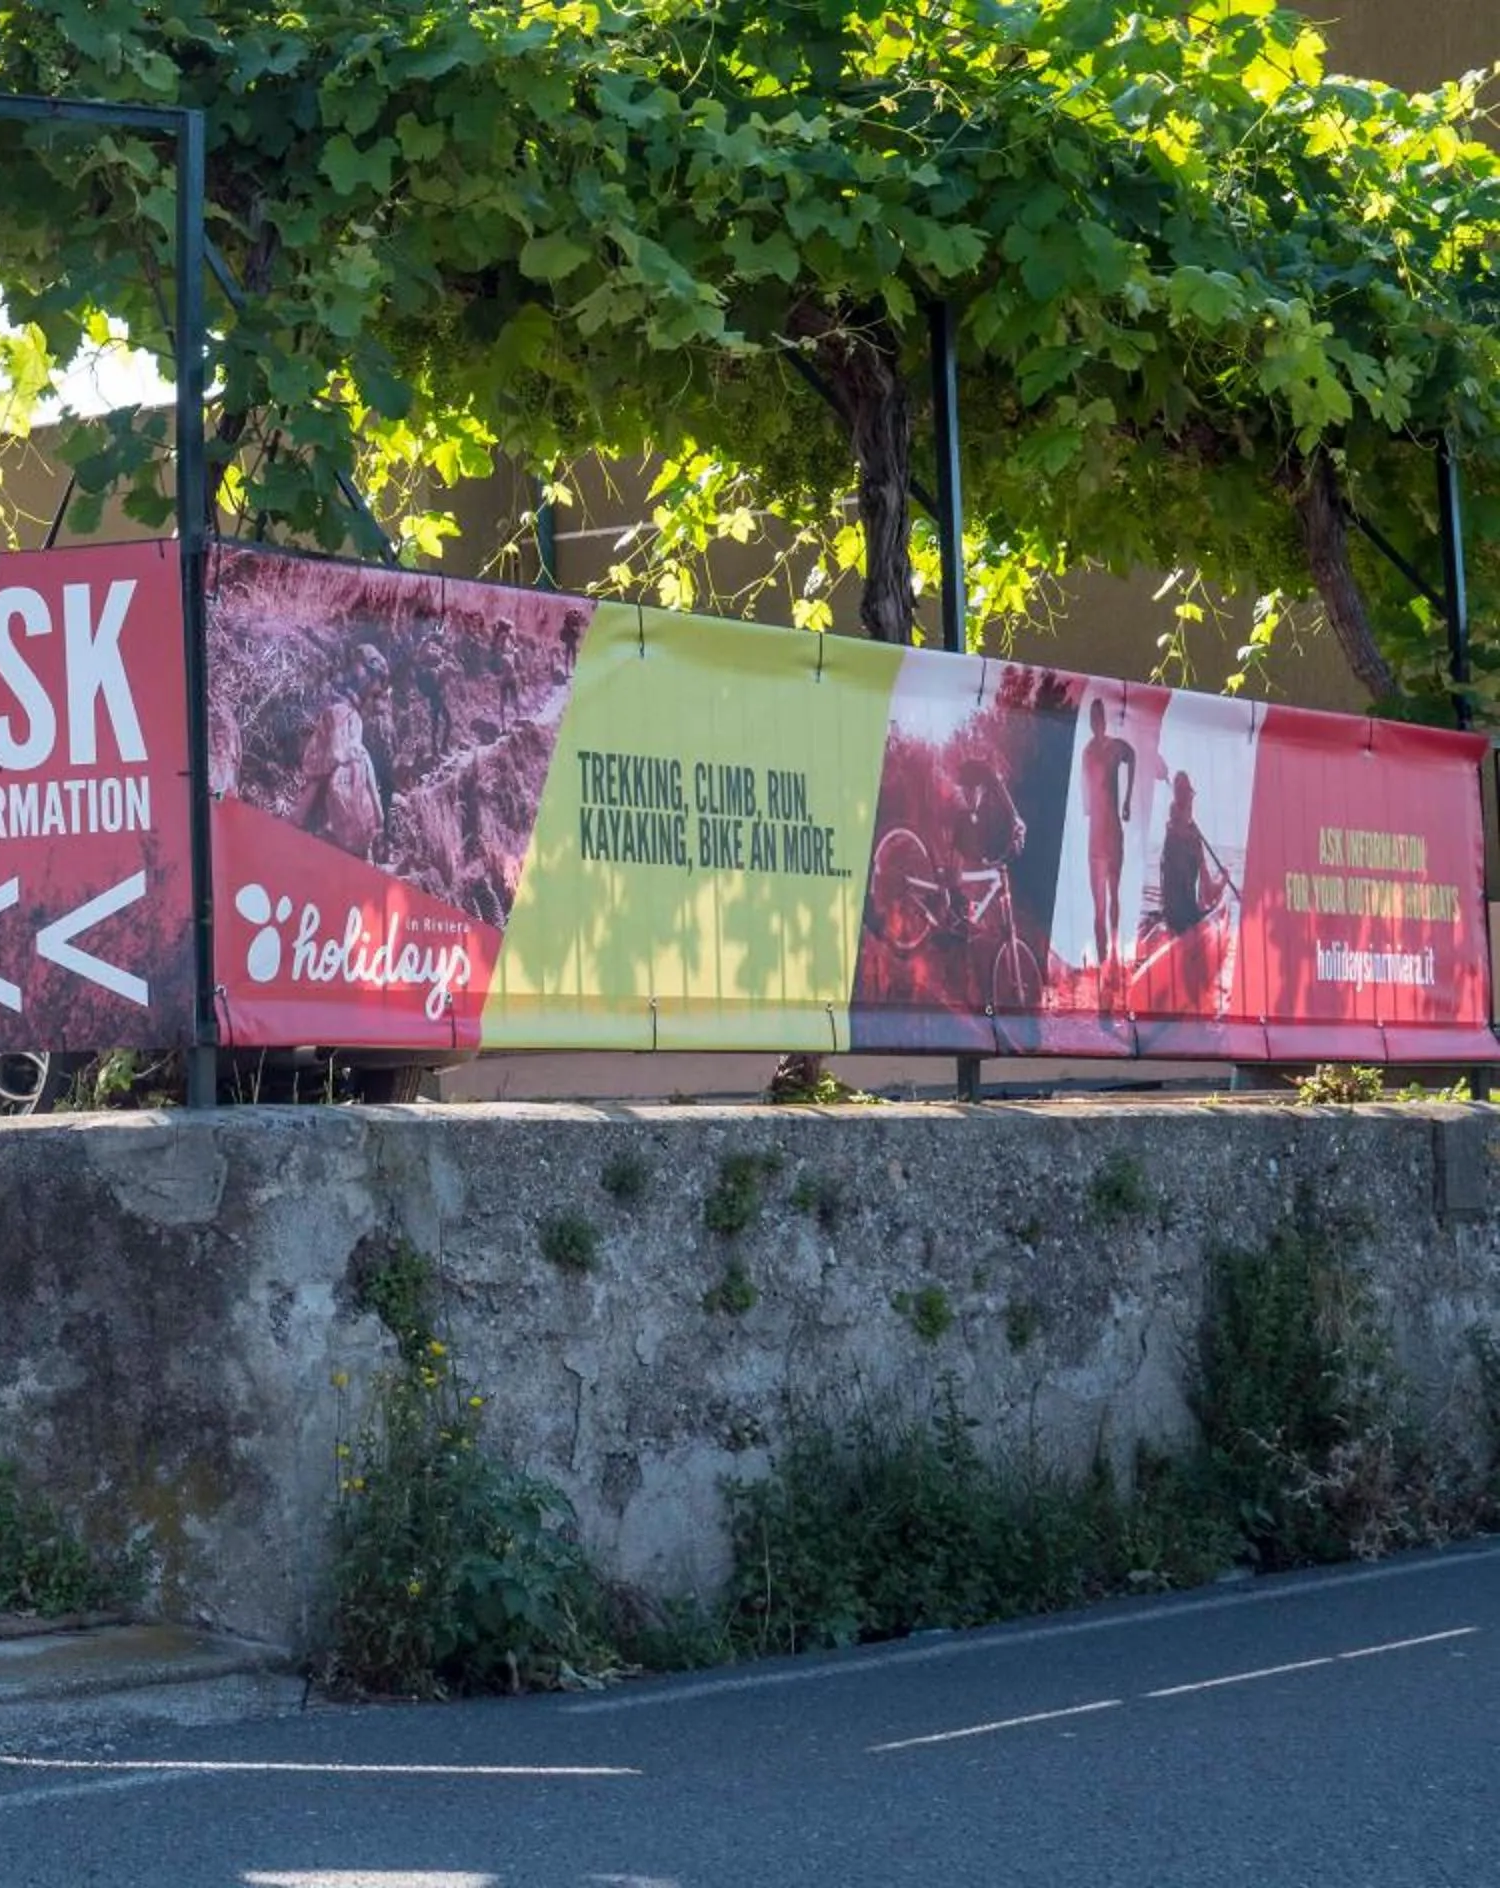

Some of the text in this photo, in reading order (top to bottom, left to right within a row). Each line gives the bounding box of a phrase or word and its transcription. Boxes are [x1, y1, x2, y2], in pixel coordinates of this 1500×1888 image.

[577, 751, 813, 826] TREKKING, CLIMB, RUN,
[580, 806, 852, 878] KAYAKING, BIKE AN MORE...
[1319, 826, 1345, 866] ASK
[406, 917, 471, 934] in Riviera
[1286, 871, 1310, 912] FOR
[1312, 873, 1346, 915] YOUR
[1405, 882, 1461, 924] HOLIDAYS
[291, 903, 471, 1021] holidays
